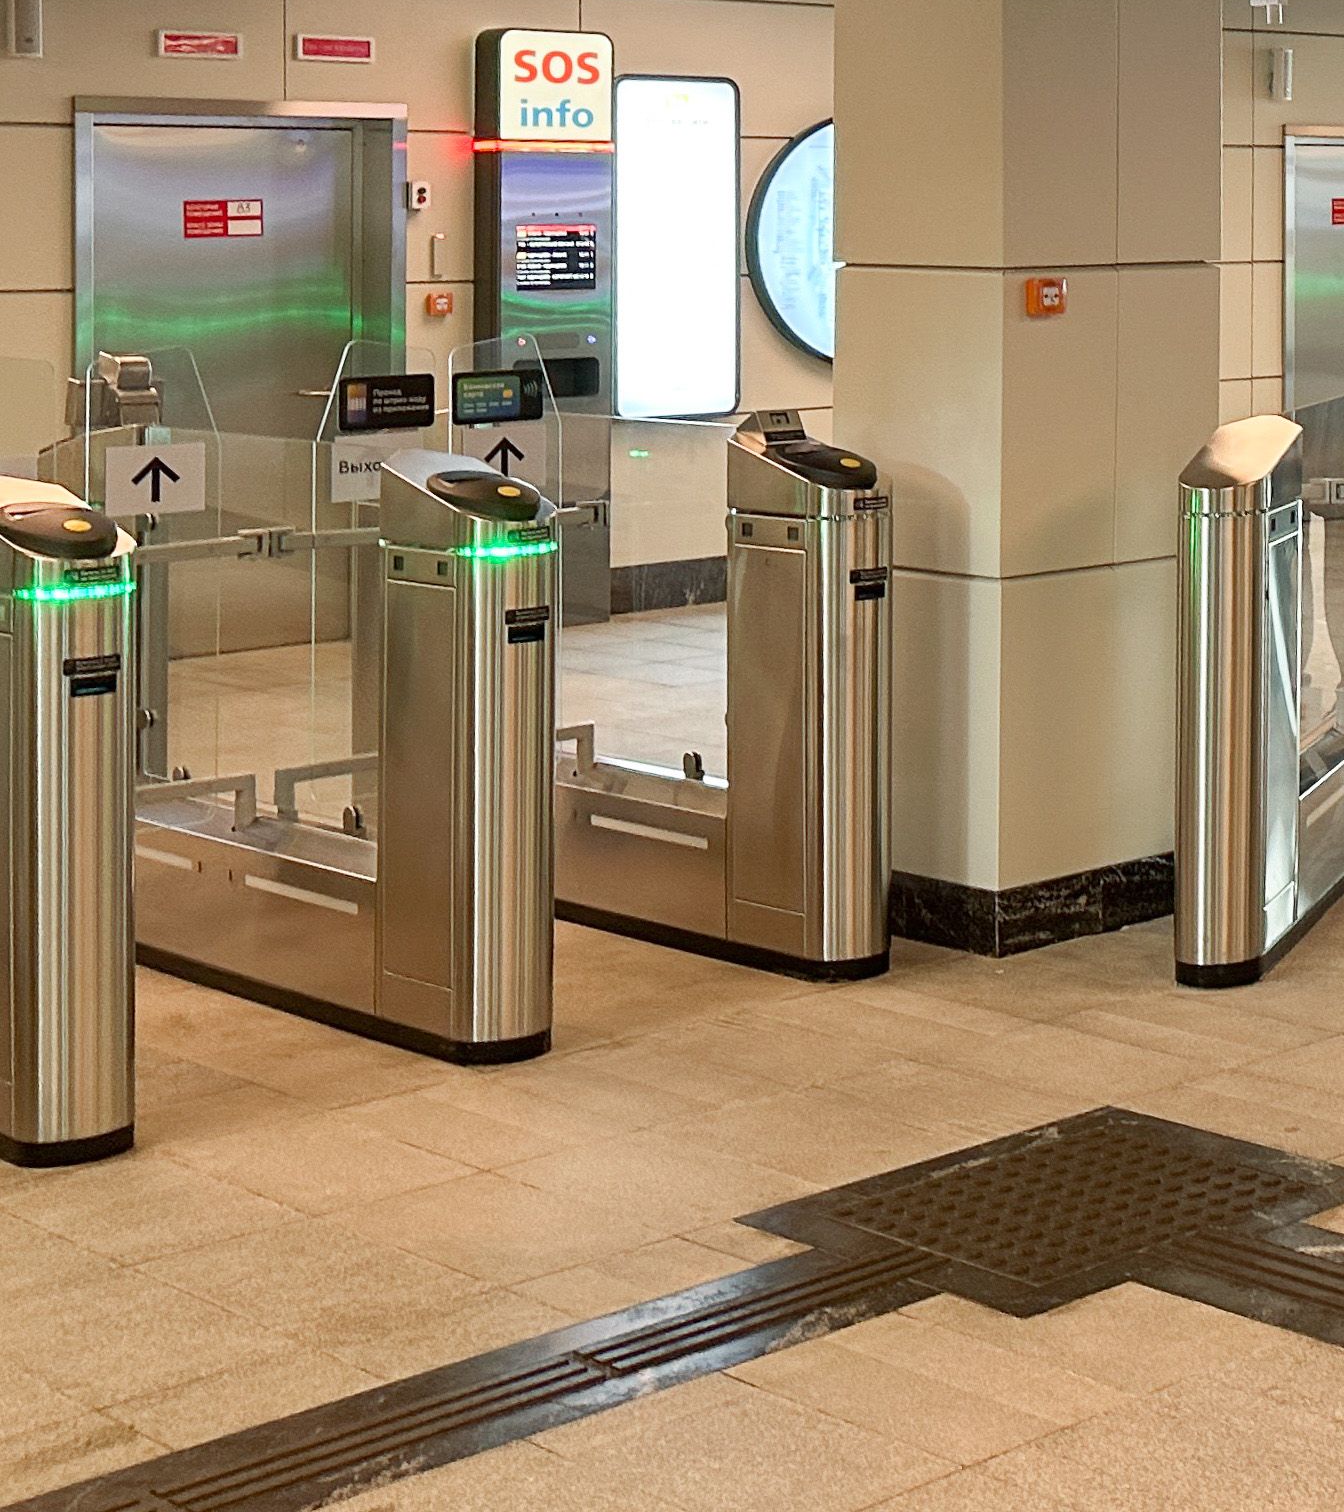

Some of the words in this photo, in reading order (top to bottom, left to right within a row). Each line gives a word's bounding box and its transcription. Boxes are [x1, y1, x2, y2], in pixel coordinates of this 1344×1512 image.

[514, 50, 600, 85] SOS
[520, 98, 594, 128] info
[338, 461, 382, 474] Выхо
